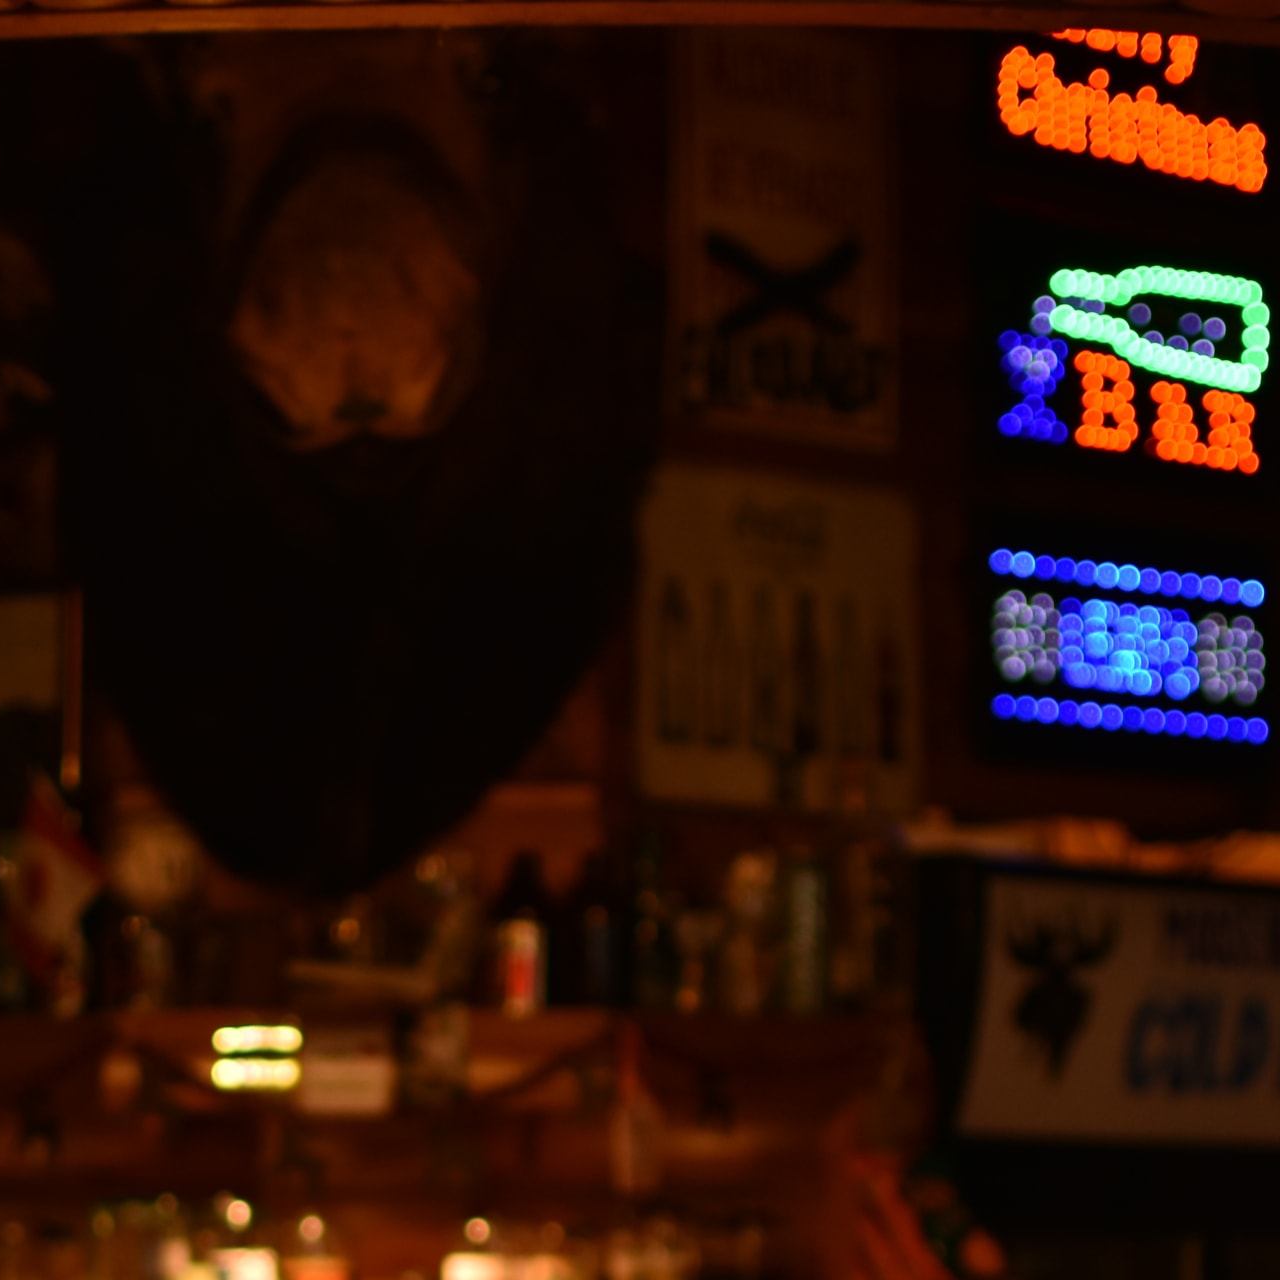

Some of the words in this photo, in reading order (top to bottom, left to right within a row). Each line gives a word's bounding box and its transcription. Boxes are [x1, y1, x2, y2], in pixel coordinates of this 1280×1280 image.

[998, 46, 1267, 193] Christmas
[1075, 350, 1260, 474] BAR
[1126, 996, 1272, 1095] COLD
